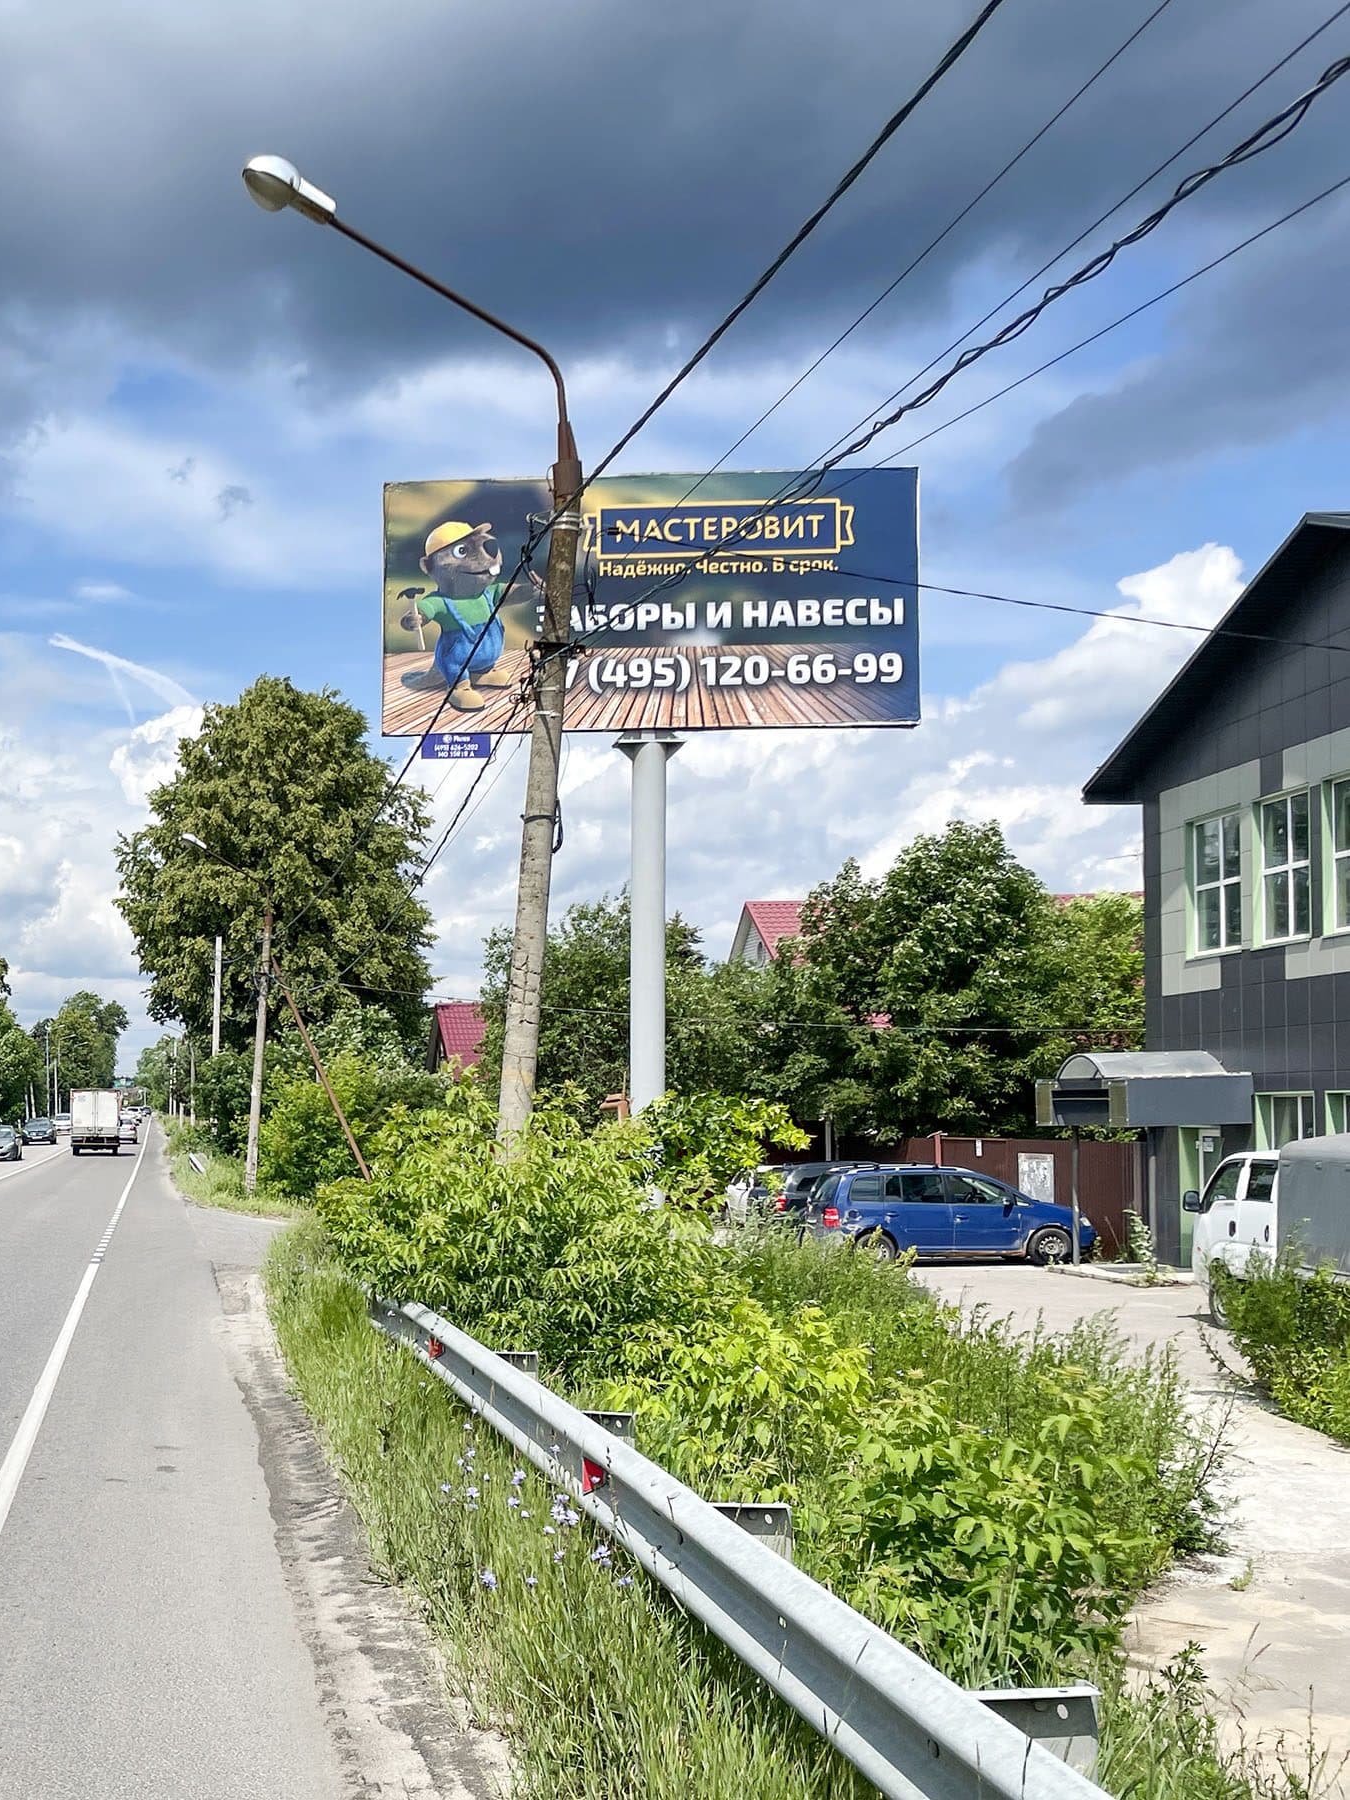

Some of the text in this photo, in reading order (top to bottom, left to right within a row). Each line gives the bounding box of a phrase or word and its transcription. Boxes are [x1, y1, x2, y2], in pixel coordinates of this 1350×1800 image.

[615, 514, 826, 543] МАСТЕРОВИТ
[696, 557, 768, 575] Честно.
[772, 557, 786, 573] В
[788, 559, 839, 576] срок.
[706, 600, 732, 630] И
[742, 597, 905, 628] НАВЕСЫ
[587, 653, 692, 693] (495)
[700, 652, 904, 688] 120-66-99
